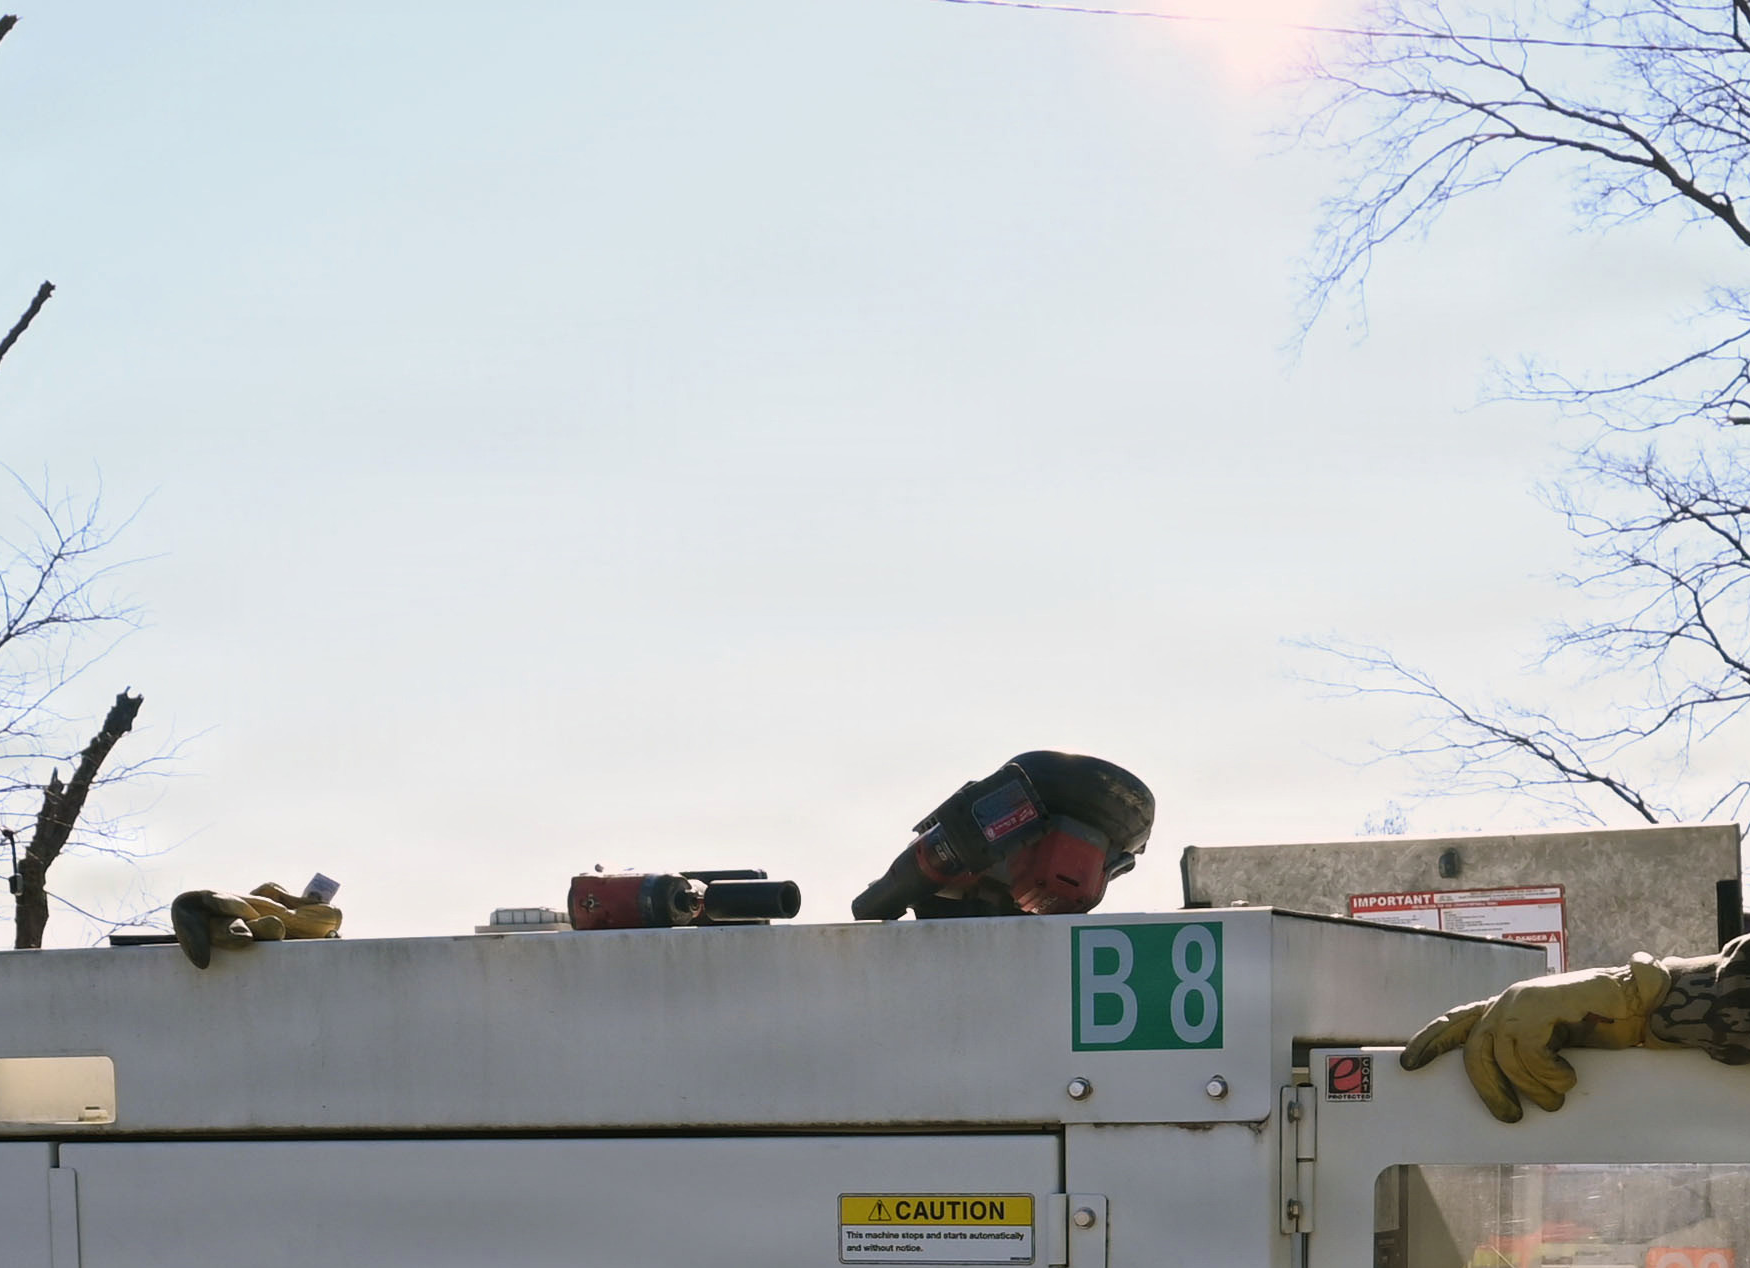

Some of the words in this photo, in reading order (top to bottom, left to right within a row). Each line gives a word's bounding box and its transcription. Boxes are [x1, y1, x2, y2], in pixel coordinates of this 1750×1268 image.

[1353, 895, 1432, 908] IMPORTANT
[1079, 929, 1138, 1044] B
[1170, 924, 1219, 1044] 8
[895, 1201, 1005, 1220] CAUTION
[846, 1231, 863, 1239] This
[865, 1231, 899, 1240] machine
[901, 1232, 924, 1241] stops
[926, 1231, 942, 1240] and
[943, 1232, 967, 1240] starts
[969, 1231, 1025, 1241] automatically
[846, 1244, 862, 1252] and
[863, 1243, 894, 1252] without
[896, 1244, 923, 1252] notice.
